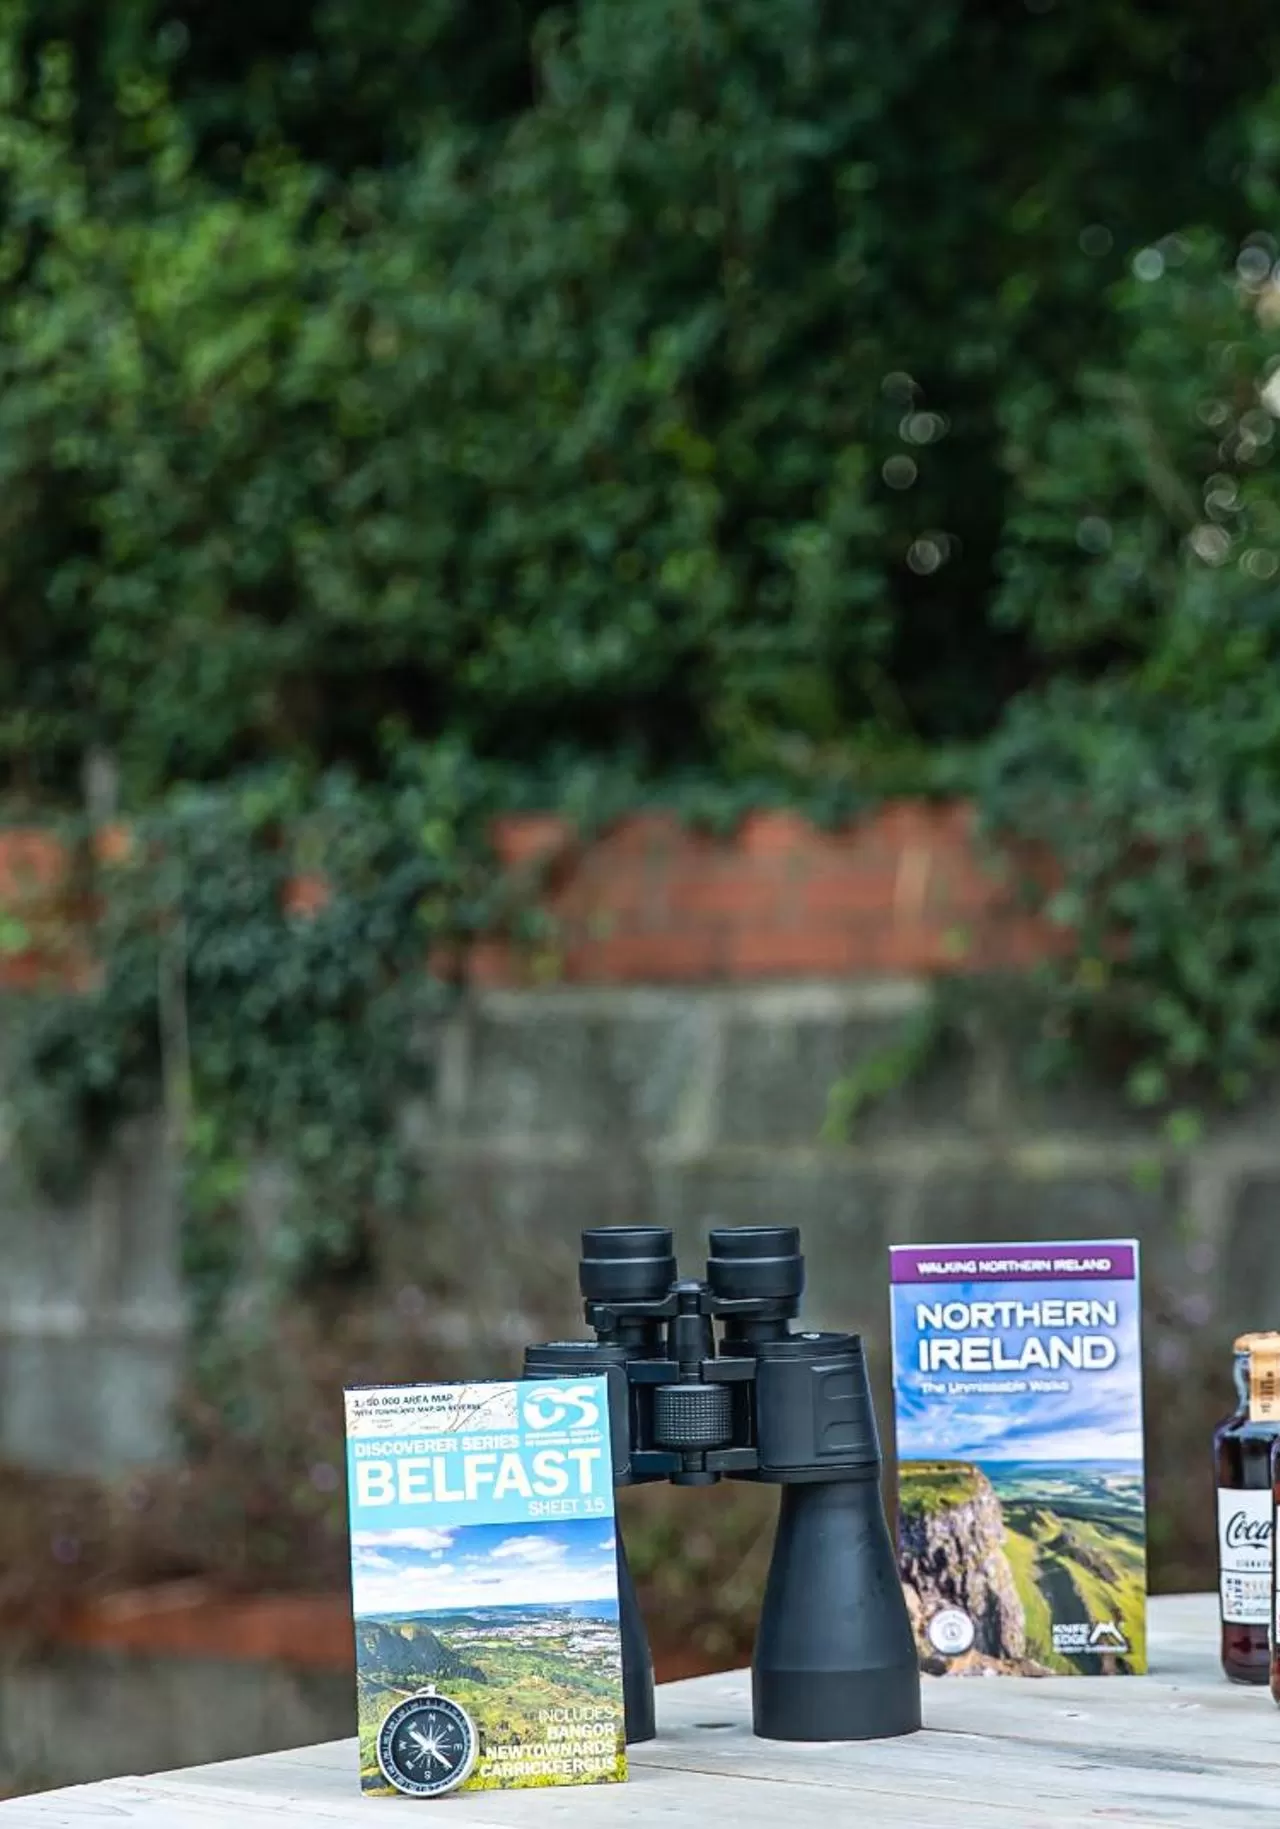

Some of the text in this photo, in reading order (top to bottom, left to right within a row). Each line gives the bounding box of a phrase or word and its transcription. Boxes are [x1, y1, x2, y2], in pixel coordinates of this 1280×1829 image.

[917, 1258, 1111, 1274] WALKING NORTHERN IRELAND
[916, 1300, 1117, 1330] NORTHERN
[919, 1335, 1117, 1372] IRELAND
[431, 1393, 453, 1403] MAP
[354, 1439, 457, 1456] DISCOVERER
[462, 1434, 519, 1450] SERIES
[356, 1448, 599, 1506] BELFAST
[528, 1498, 605, 1516] SHEET 15
[1053, 1624, 1090, 1634] KNIFE
[1053, 1635, 1087, 1645] EDGE
[539, 1706, 615, 1722] INCLUDES
[547, 1723, 615, 1740] BANGOR
[486, 1740, 616, 1760] NEWTOWNARDS
[480, 1759, 617, 1778] CARRICKFERGUS
